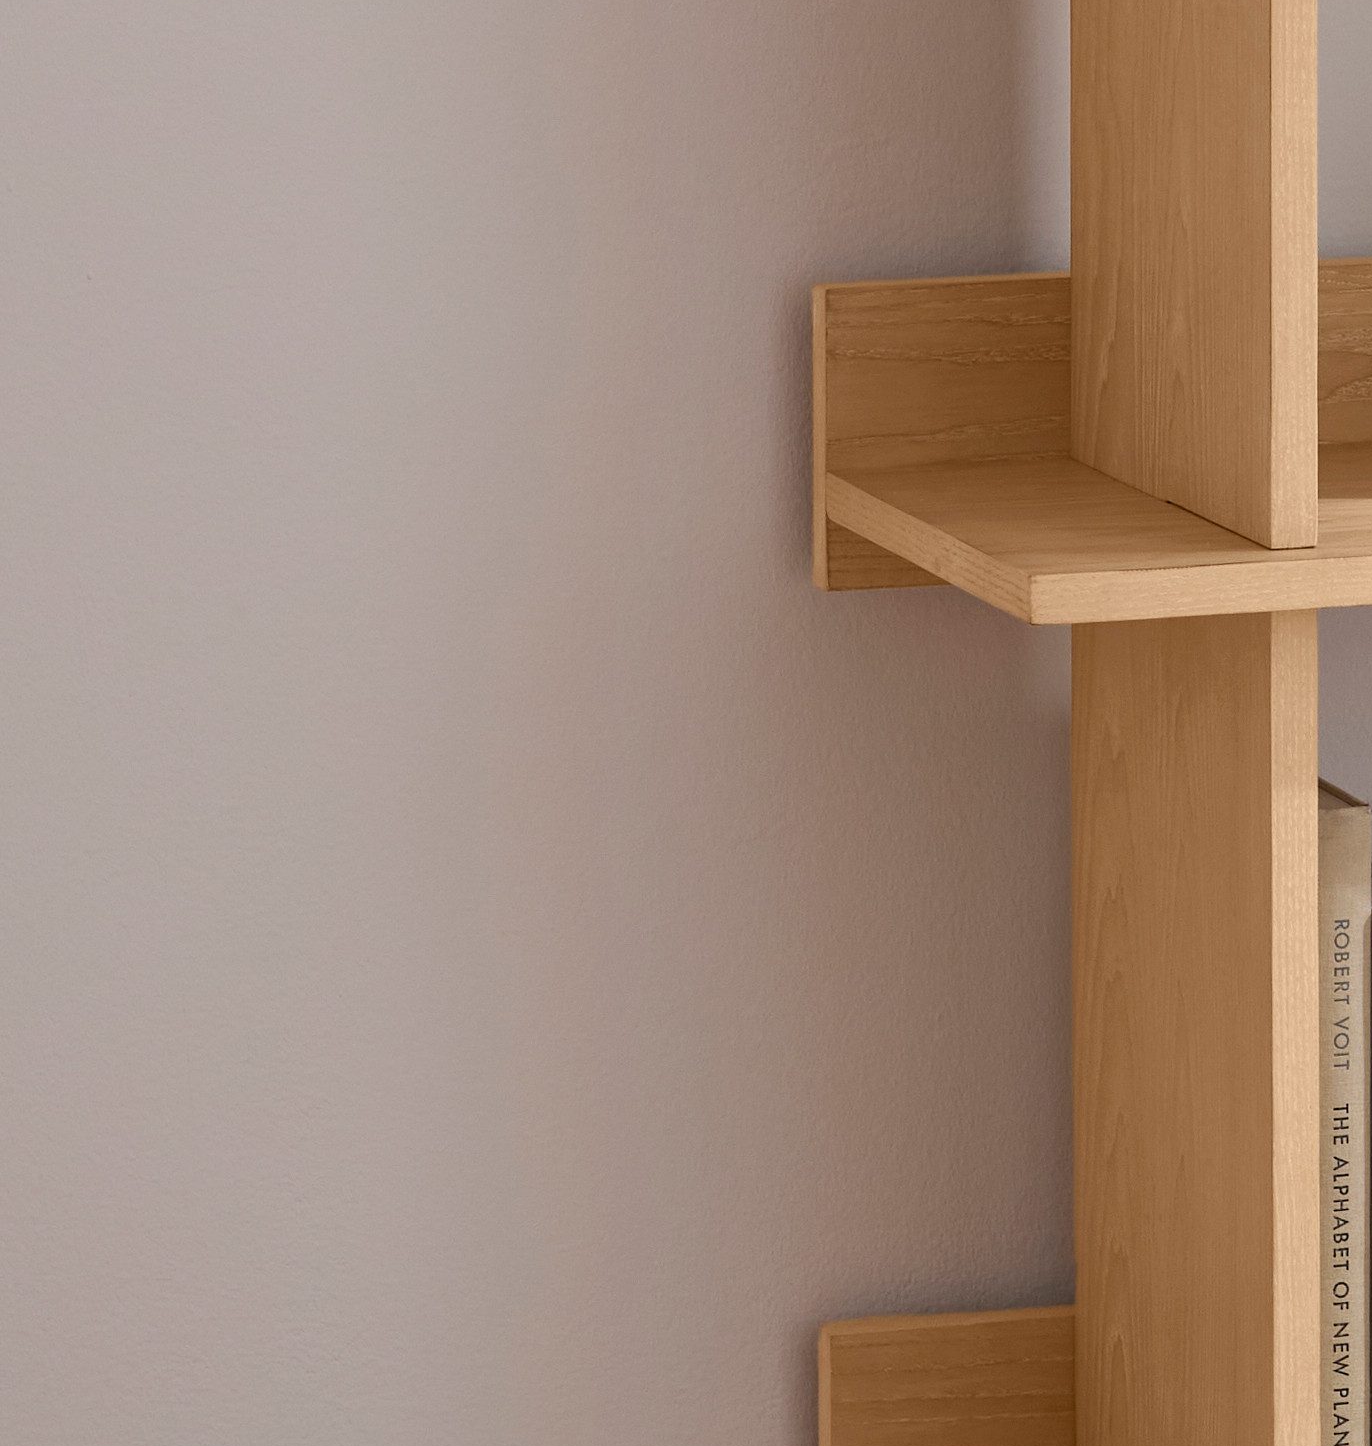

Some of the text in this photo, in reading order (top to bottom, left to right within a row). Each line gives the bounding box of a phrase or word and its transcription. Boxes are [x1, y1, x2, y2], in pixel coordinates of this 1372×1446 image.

[1333, 919, 1350, 1070] ROBERT VOIT
[1333, 1103, 1350, 1146] THE
[1333, 1156, 1350, 1271] ALPHABET
[1333, 1281, 1350, 1311] OF
[1333, 1322, 1350, 1377] NEW
